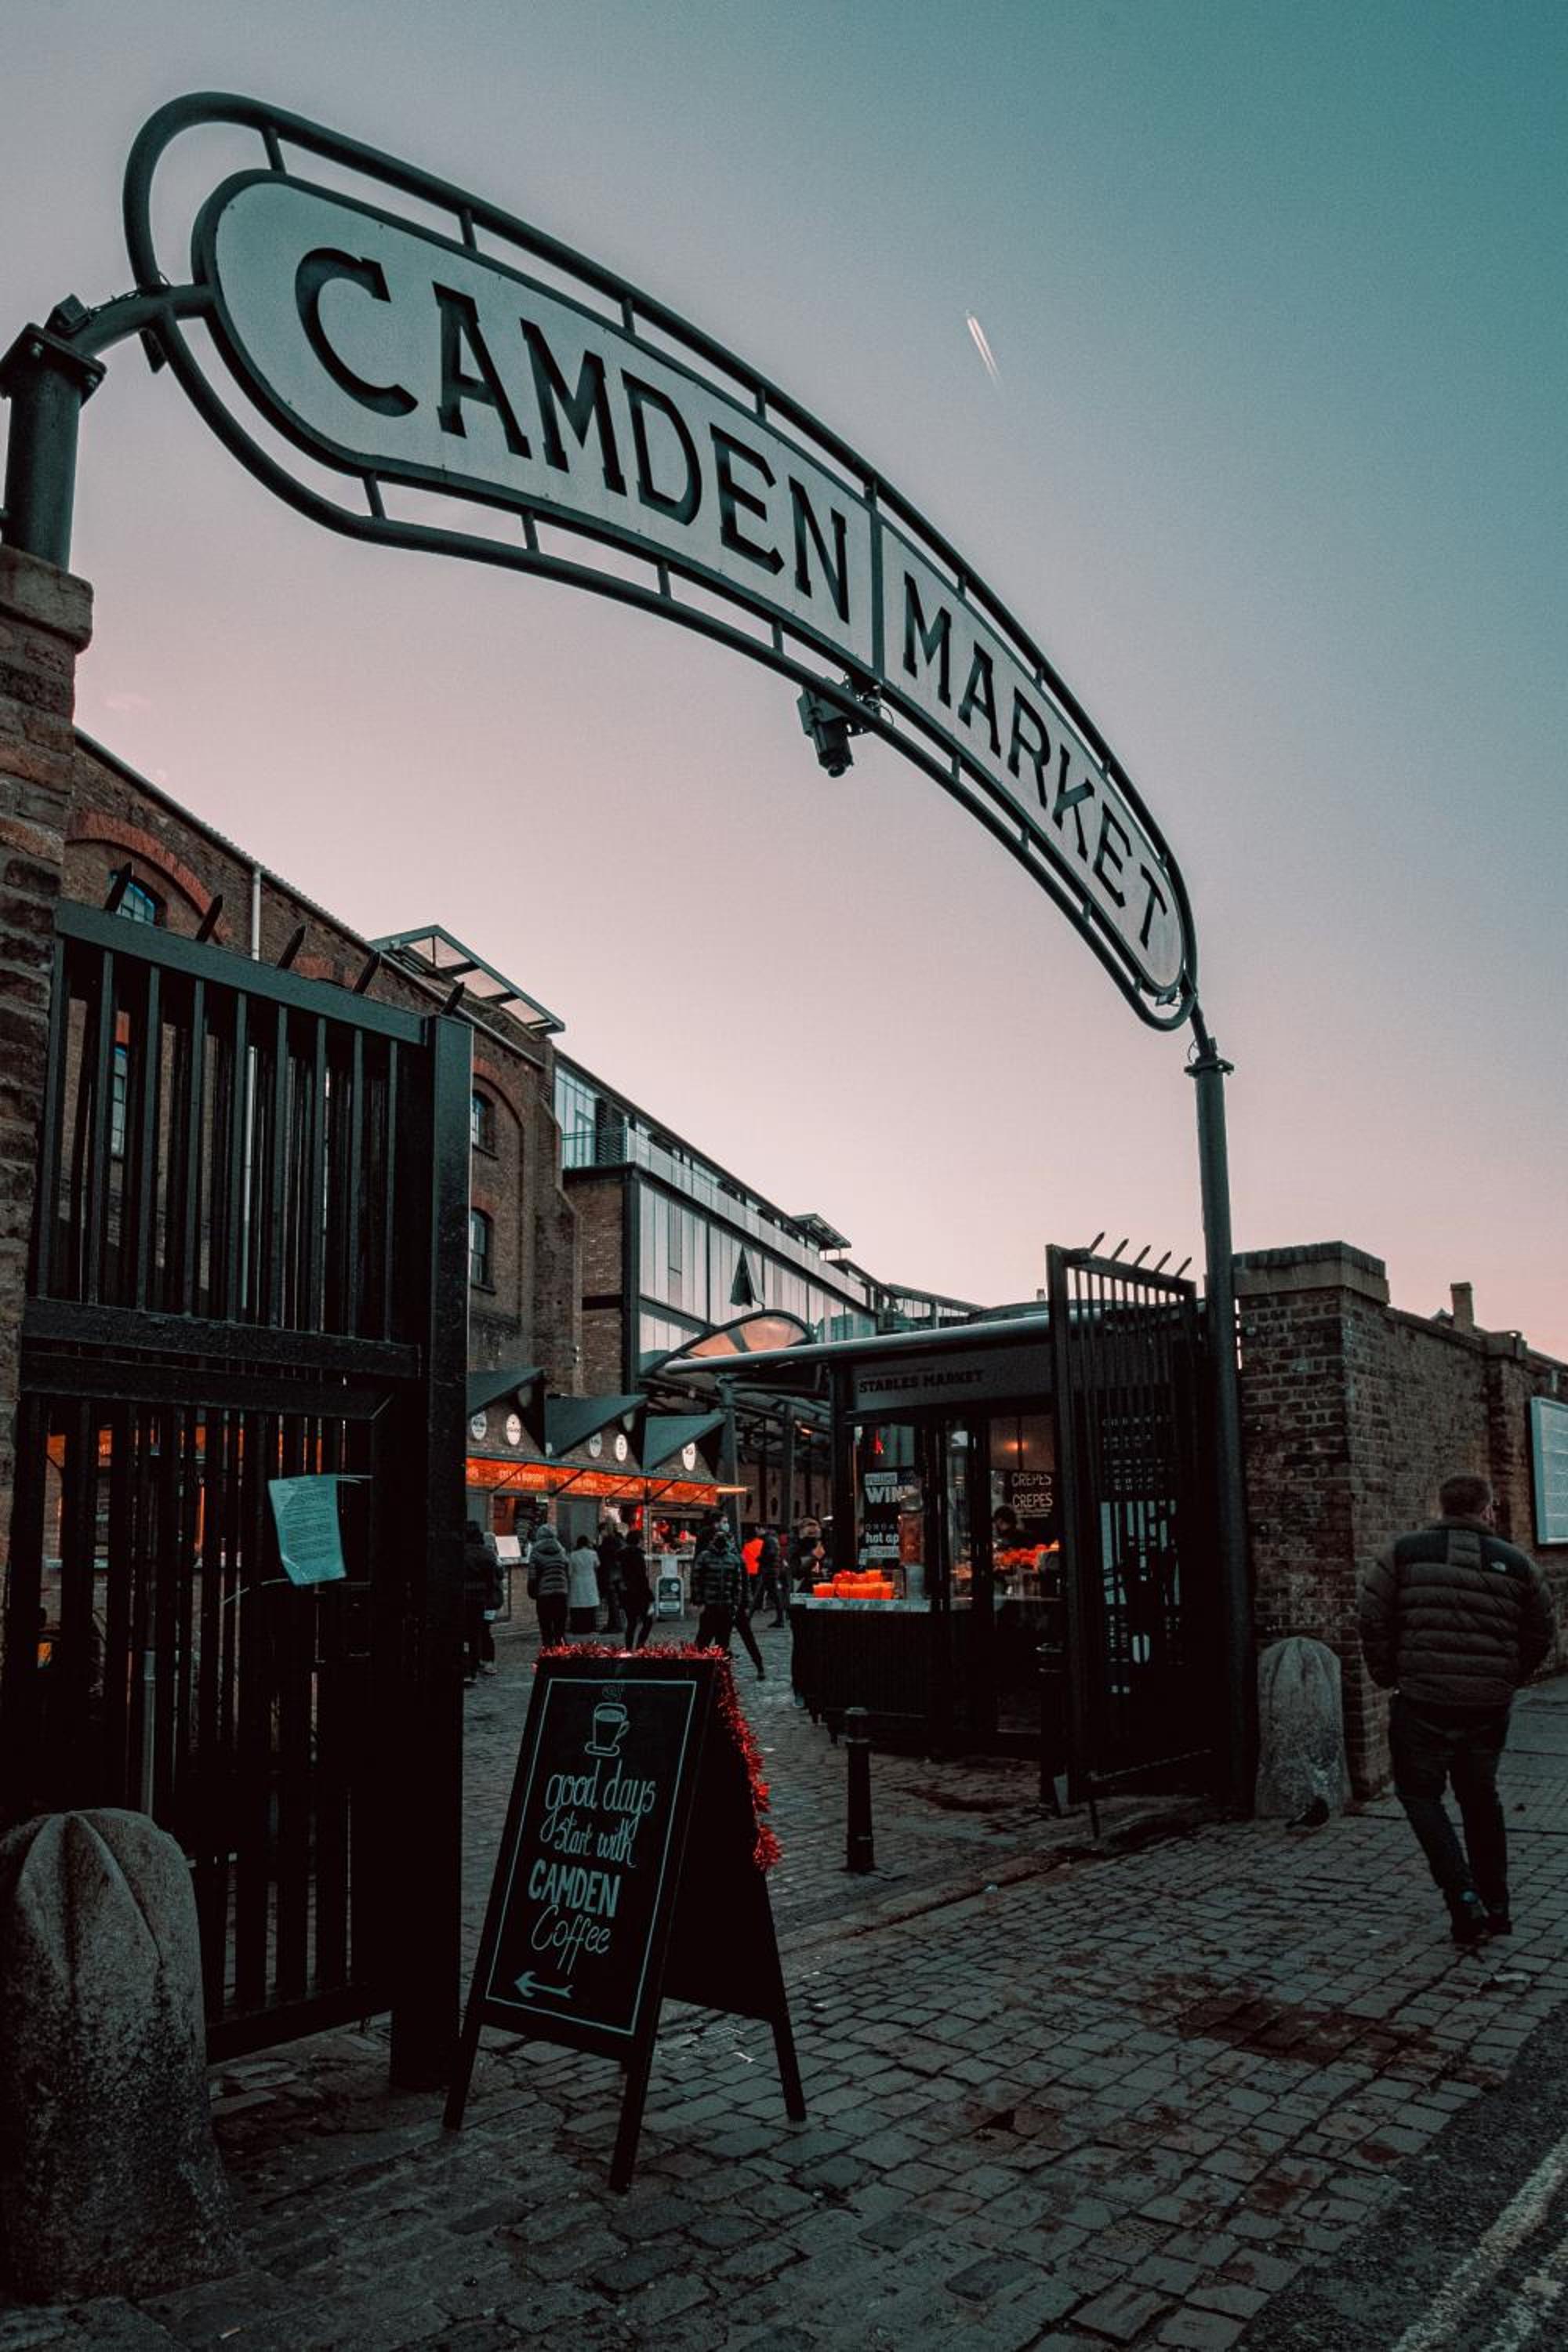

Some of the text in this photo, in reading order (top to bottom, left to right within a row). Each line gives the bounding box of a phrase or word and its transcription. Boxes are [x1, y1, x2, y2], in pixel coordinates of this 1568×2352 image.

[295, 246, 1167, 949] CAMDEN MARKET
[859, 1376, 918, 1393] STABLES
[865, 1486, 914, 1504] WIN
[1012, 1492, 1054, 1508] CREPES
[865, 1531, 884, 1544] hot
[539, 1759, 657, 1842] good days
[596, 1817, 640, 1868] with
[528, 1858, 622, 1918] CAMDEN
[531, 1904, 612, 1976] Coffee
